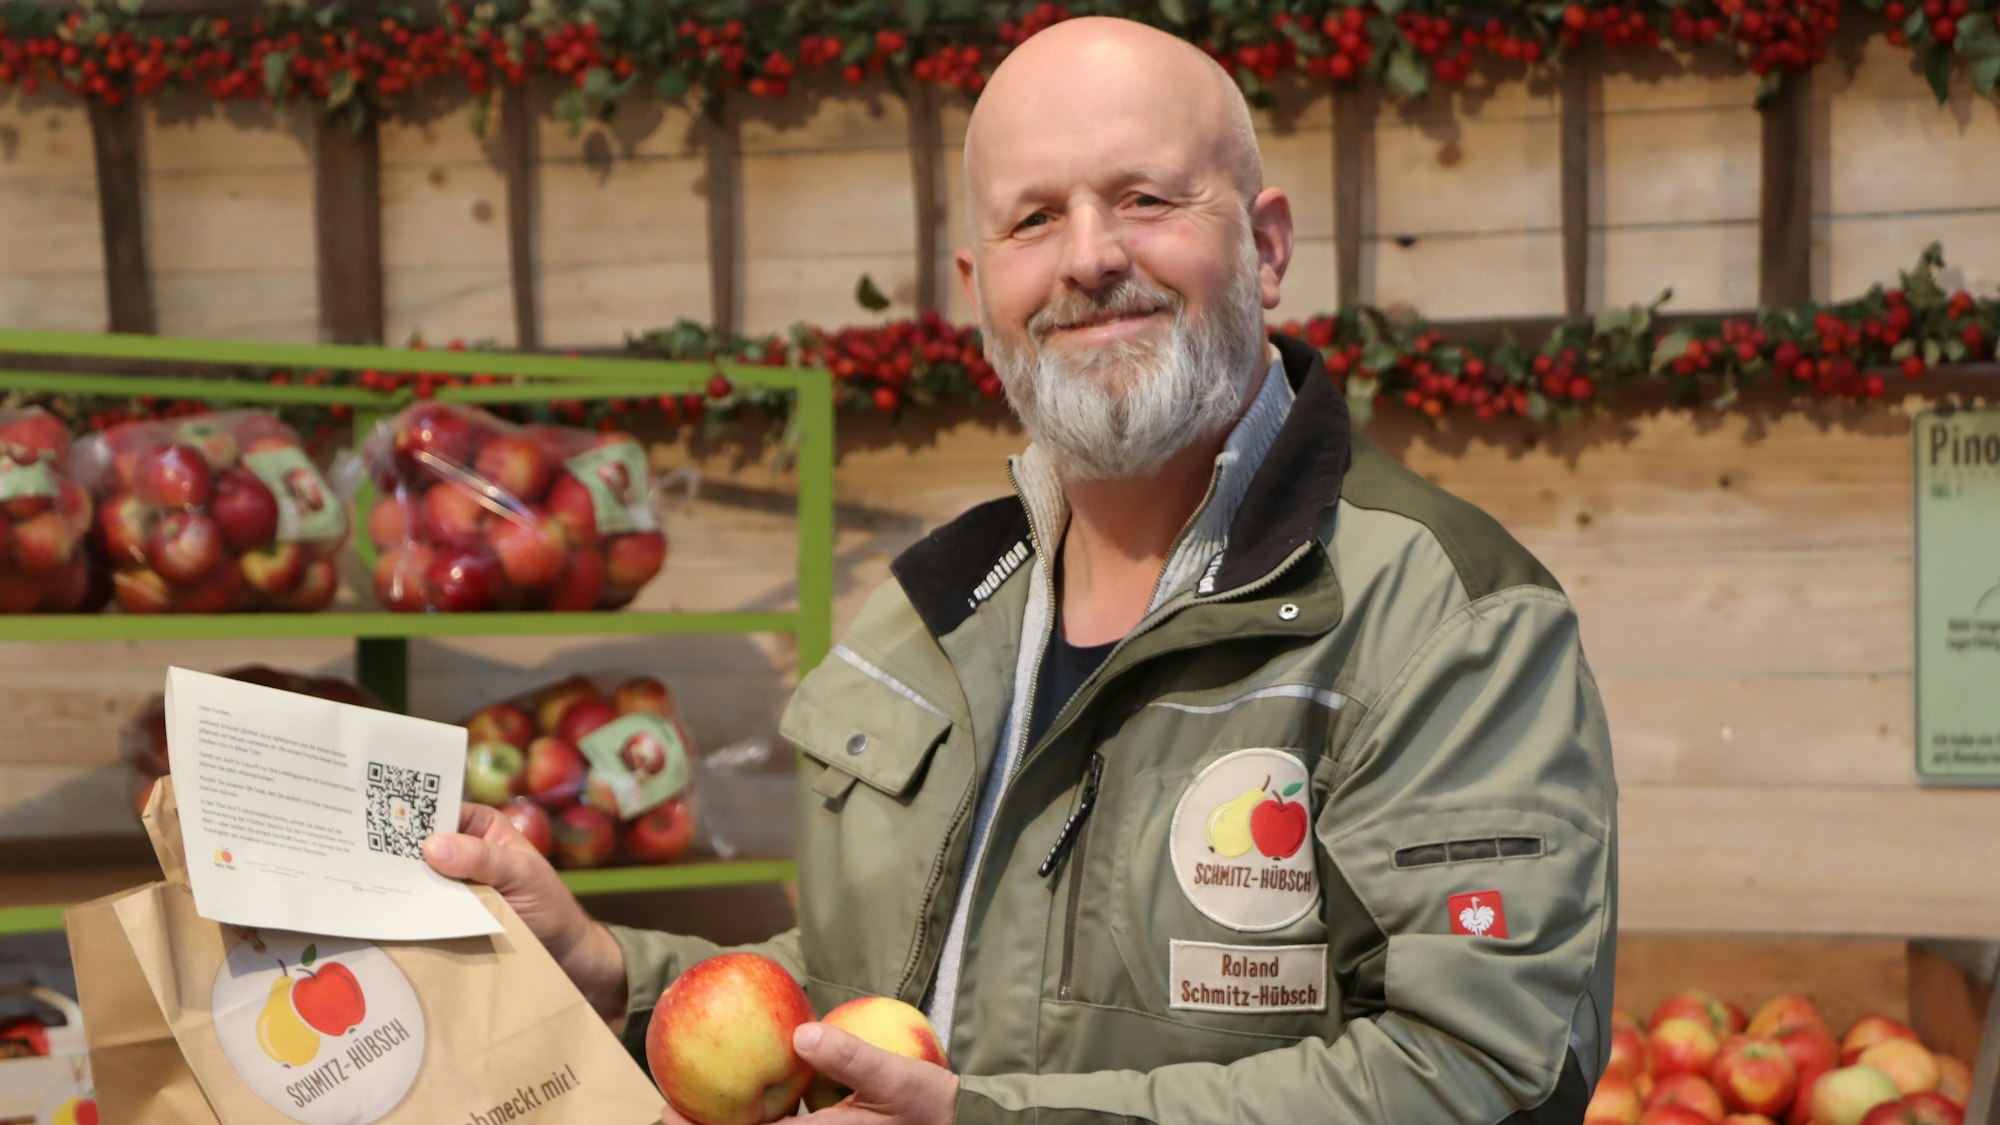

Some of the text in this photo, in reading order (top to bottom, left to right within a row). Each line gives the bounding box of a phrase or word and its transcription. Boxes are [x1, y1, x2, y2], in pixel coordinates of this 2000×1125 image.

[973, 541, 1029, 601] motion
[1194, 863, 1312, 892] SCHMITZ-HÜBSCH
[1221, 954, 1279, 977] Roland
[1181, 980, 1317, 1006] Schmitz-Hübsch
[286, 1018, 410, 1108] SCHMITZ-HÜBSCH
